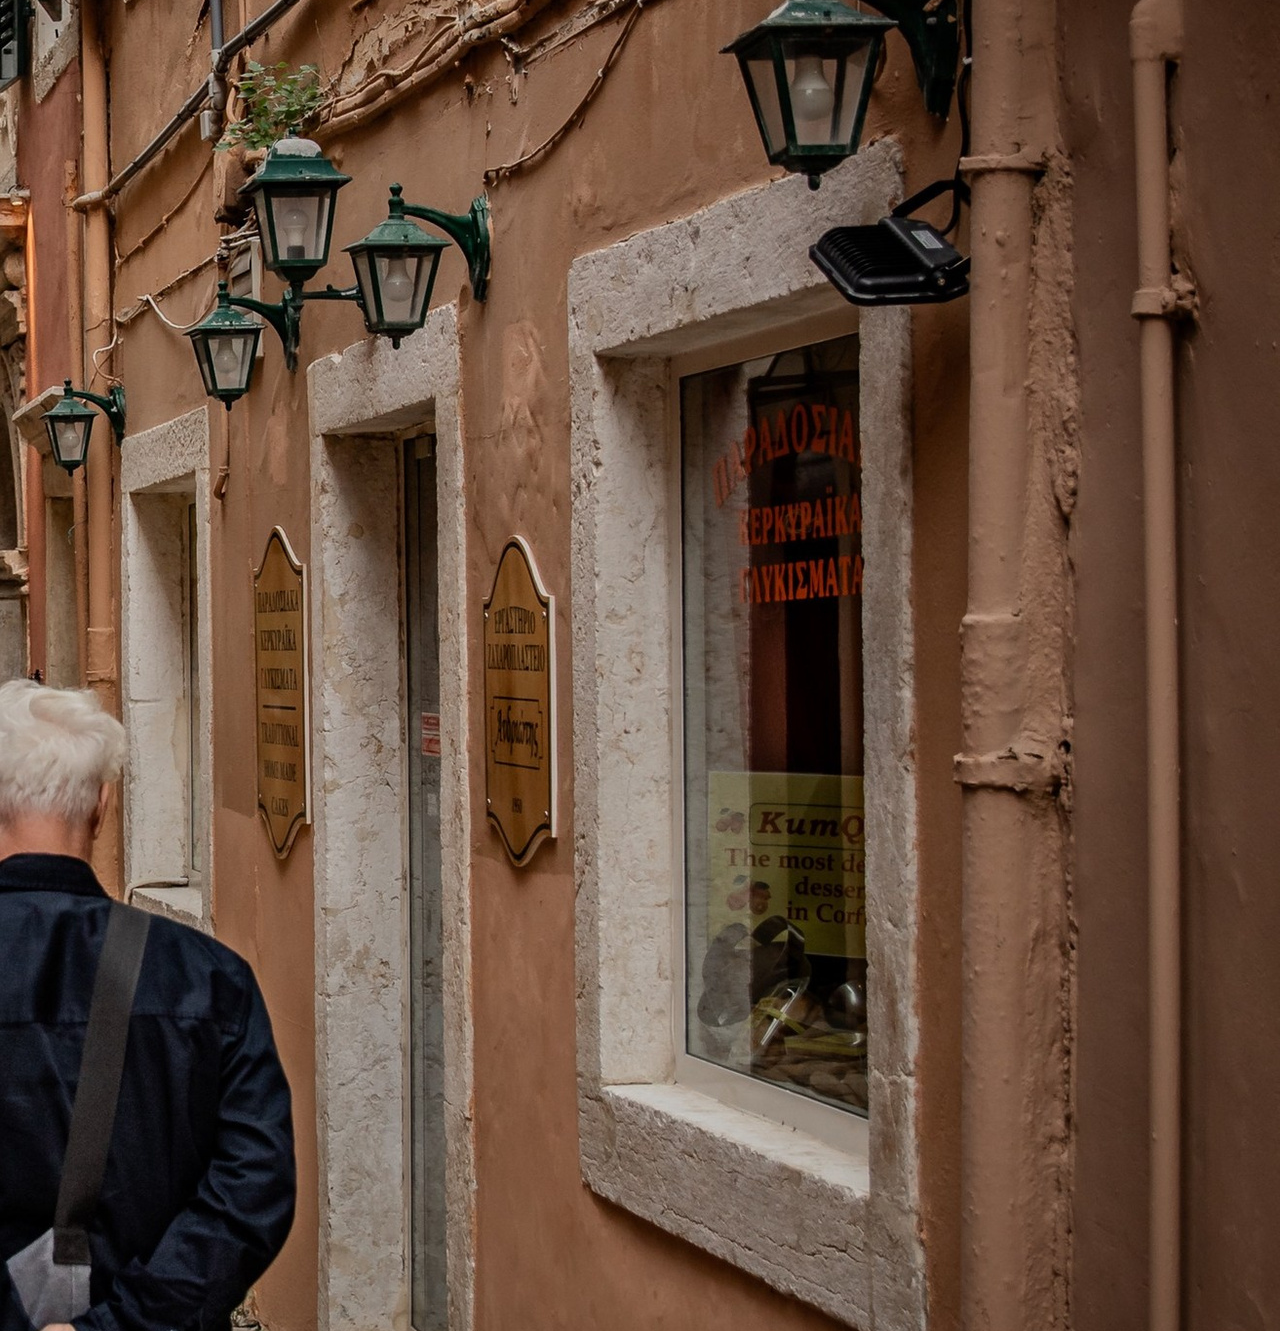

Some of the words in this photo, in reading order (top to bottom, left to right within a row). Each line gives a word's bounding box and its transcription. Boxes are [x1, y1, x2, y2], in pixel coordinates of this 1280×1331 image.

[712, 402, 862, 508] ΠΑΡΑΔΟΣΙΑ
[494, 606, 536, 634] ΕΡΓΑΣΤΗΡΙΟ
[487, 644, 545, 672] ΖΑΧΑΡΟΠΛΑΣΤΕΙΟ
[261, 722, 299, 747] TRADITIONAL
[263, 759, 279, 779] HOME
[279, 761, 297, 782] MADE
[271, 796, 289, 817] CAKES
[757, 811, 864, 844] KumQ
[724, 848, 770, 868] The
[779, 854, 835, 871] most
[841, 852, 864, 873] de
[795, 876, 864, 899] desser
[787, 901, 808, 920] in
[816, 903, 866, 925] Corf
